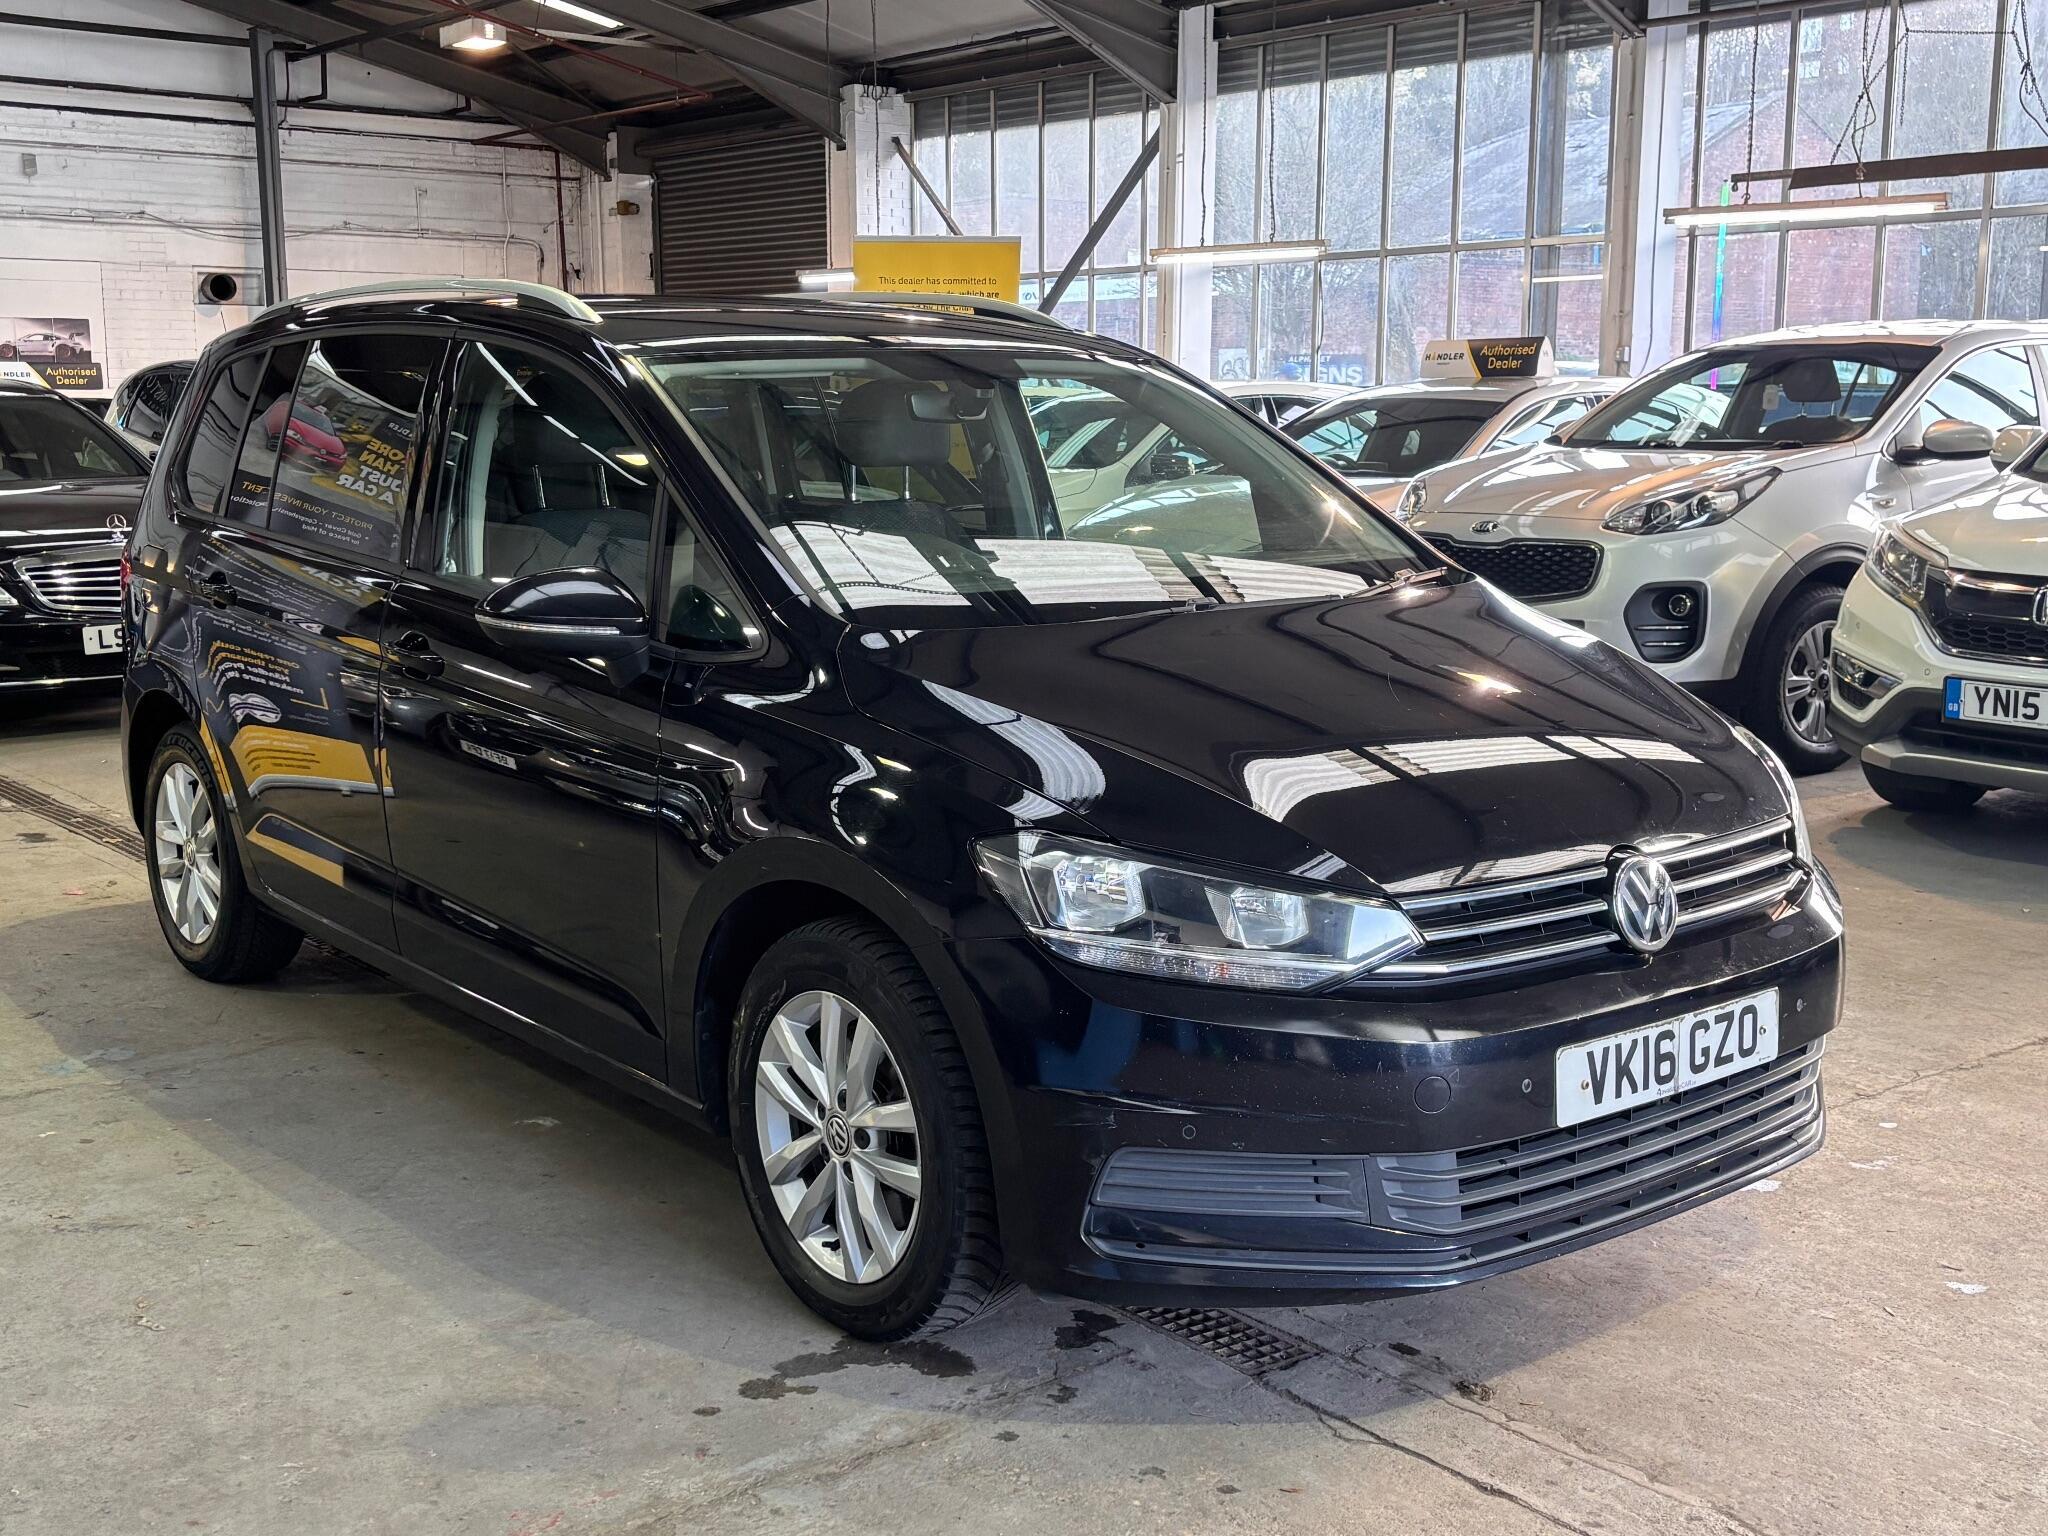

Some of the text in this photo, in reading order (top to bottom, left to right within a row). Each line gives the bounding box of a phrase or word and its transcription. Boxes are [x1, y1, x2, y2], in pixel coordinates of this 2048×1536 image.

[878, 276, 997, 285] This dealer has committed to
[1480, 343, 1537, 356] Authorised
[1488, 357, 1523, 369] Dealer
[46, 367, 97, 376] Authorised
[56, 376, 88, 385] Dealer
[1947, 702, 1959, 712] GB
[1974, 685, 2041, 721] YN15
[1586, 1003, 1759, 1106] VK16 GZO
